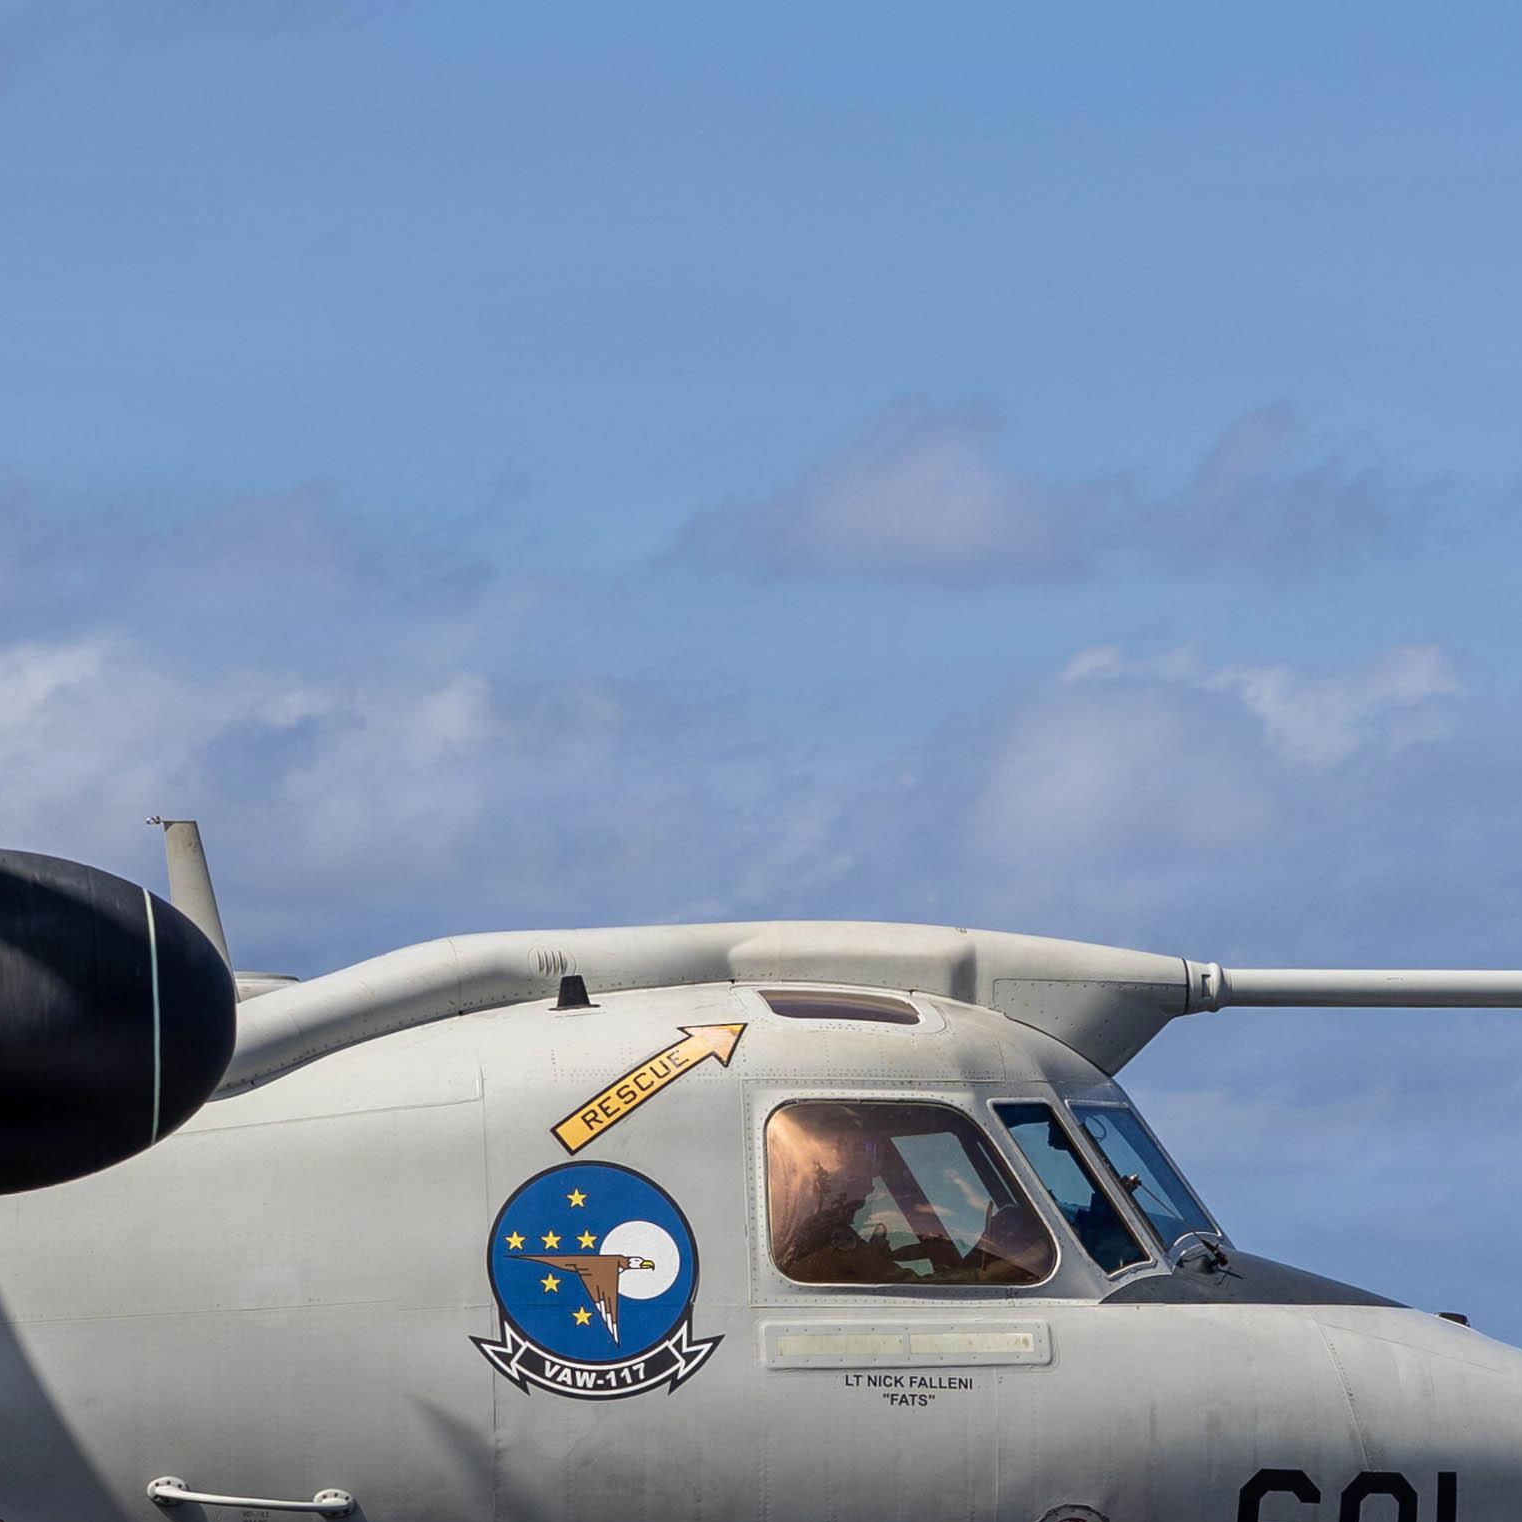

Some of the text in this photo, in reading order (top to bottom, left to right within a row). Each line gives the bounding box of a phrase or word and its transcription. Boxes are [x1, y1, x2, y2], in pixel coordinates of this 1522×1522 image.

[580, 1050, 689, 1131] RESCUE
[544, 1361, 646, 1388] VAW-117
[845, 1375, 973, 1390] LT NICK FALLENI
[883, 1393, 935, 1406] "FATS"
